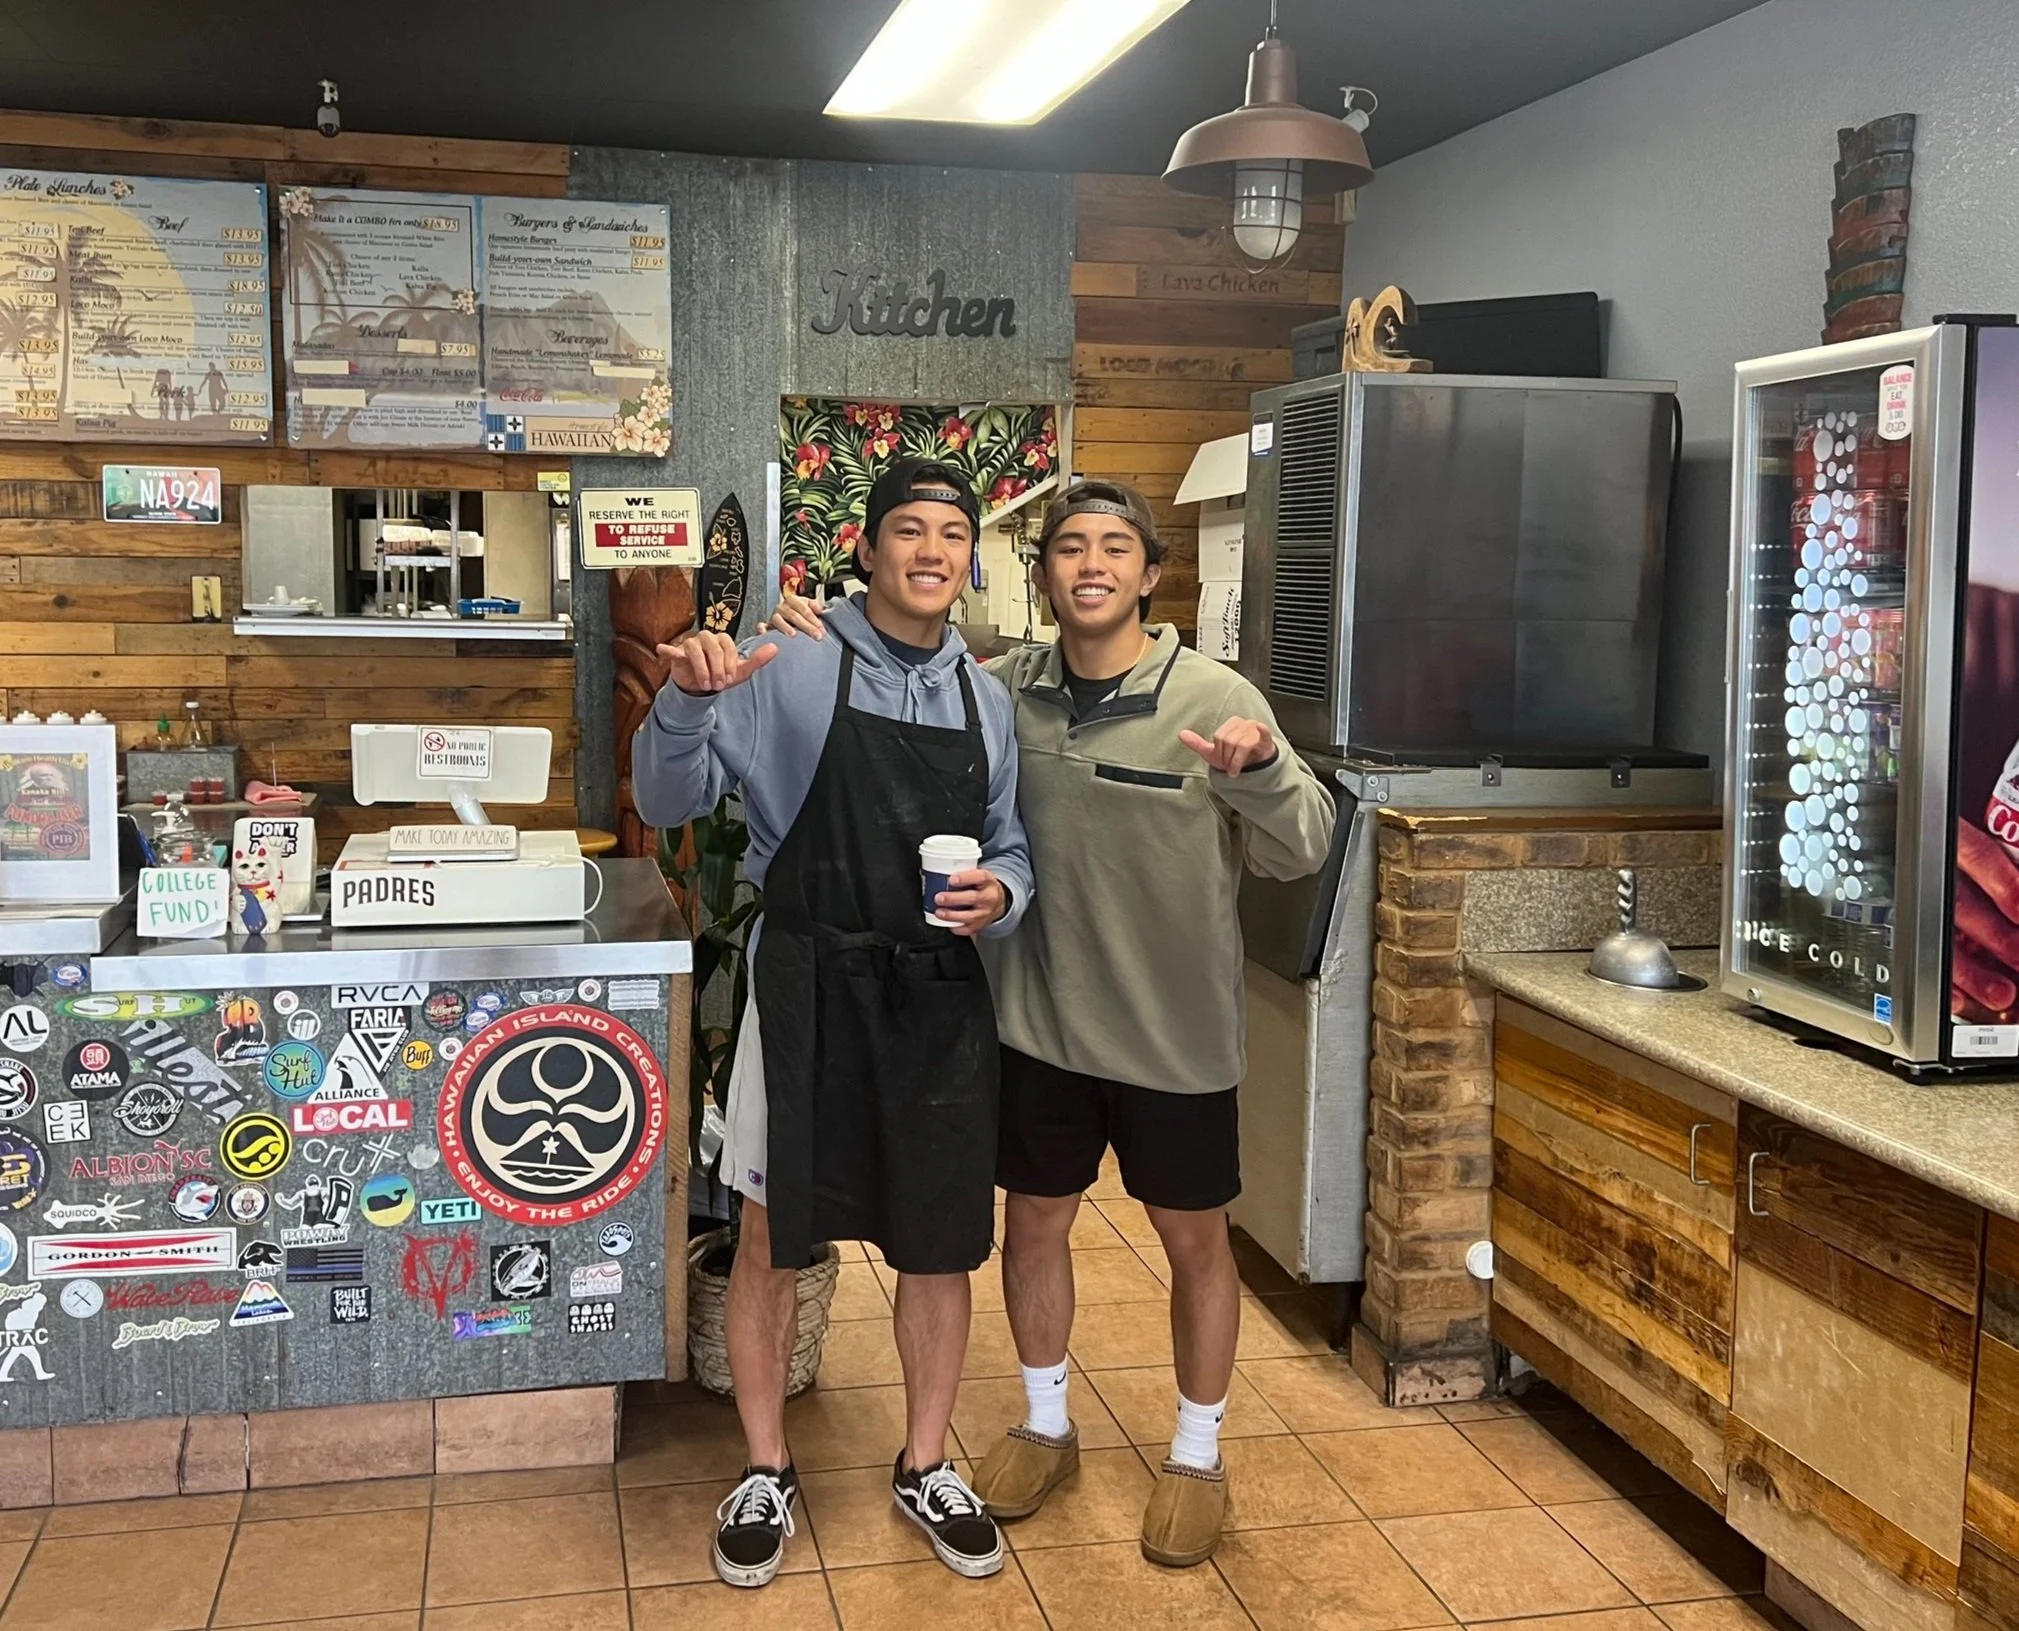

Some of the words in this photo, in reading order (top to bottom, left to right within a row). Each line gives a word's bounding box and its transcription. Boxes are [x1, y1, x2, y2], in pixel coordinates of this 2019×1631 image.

[4, 175, 42, 191] Plate
[46, 178, 107, 197] Lunches
[148, 215, 190, 234] Beef
[354, 216, 388, 226] COMBO
[504, 212, 558, 231] Burgers
[579, 217, 649, 234] Sandwiches
[630, 237, 666, 249] $11.95
[553, 256, 593, 266] Sandwich
[633, 258, 664, 268] $11.95
[1208, 272, 1280, 294] Chicken
[811, 269, 1017, 337] Kitchen
[358, 324, 408, 338] Desserts
[548, 329, 609, 347] Beverages
[441, 344, 469, 355] $7.95
[1890, 391, 1903, 401] EAT
[531, 431, 613, 448] HAWAIIAN
[139, 478, 215, 511] NA924
[625, 497, 655, 506] WE
[589, 511, 635, 520] RESERVE
[639, 511, 658, 519] THE
[661, 510, 690, 519] RIGHT
[608, 525, 625, 535] TO
[628, 524, 676, 534] REFUSE
[619, 535, 666, 546] SERVICE
[615, 550, 628, 559] TO
[632, 550, 672, 559] ANYONE
[424, 754, 487, 767] RESTROOMS
[251, 823, 298, 837] DON'T
[394, 829, 422, 845] MAKE
[429, 829, 458, 845] TODAY
[462, 830, 510, 846] AMAZING
[142, 872, 217, 895] COLLEGE
[342, 876, 435, 909] PADRES
[1807, 943, 1890, 984] COLD
[338, 984, 422, 1004] RVCA
[406, 1045, 431, 1066] Buff
[269, 1050, 312, 1078] Surf
[70, 1071, 122, 1087] ATAMA
[280, 1069, 321, 1090] Hut
[314, 1088, 380, 1101] ALLIANCE
[444, 1029, 505, 1147] HAWAIIAN
[512, 1009, 610, 1032] ISLAND
[615, 1030, 664, 1166] CREATIONS
[113, 1099, 185, 1121] Shoyoroll
[69, 1151, 175, 1179] ALBION
[180, 1148, 212, 1170] SC
[456, 1163, 520, 1214] ENJOY
[526, 1207, 574, 1220] THE
[581, 1176, 634, 1214] RIDE
[50, 1208, 98, 1219] SQUIDCO
[425, 1201, 477, 1220] YETI
[283, 1227, 347, 1240] POWAY
[283, 1236, 345, 1247] WRESTLING
[48, 1250, 132, 1261] GORDON
[159, 1245, 219, 1256] SMITH
[332, 1286, 369, 1300] BUILT
[570, 1322, 614, 1333] SHAPES
[571, 1314, 614, 1325] GHOST
